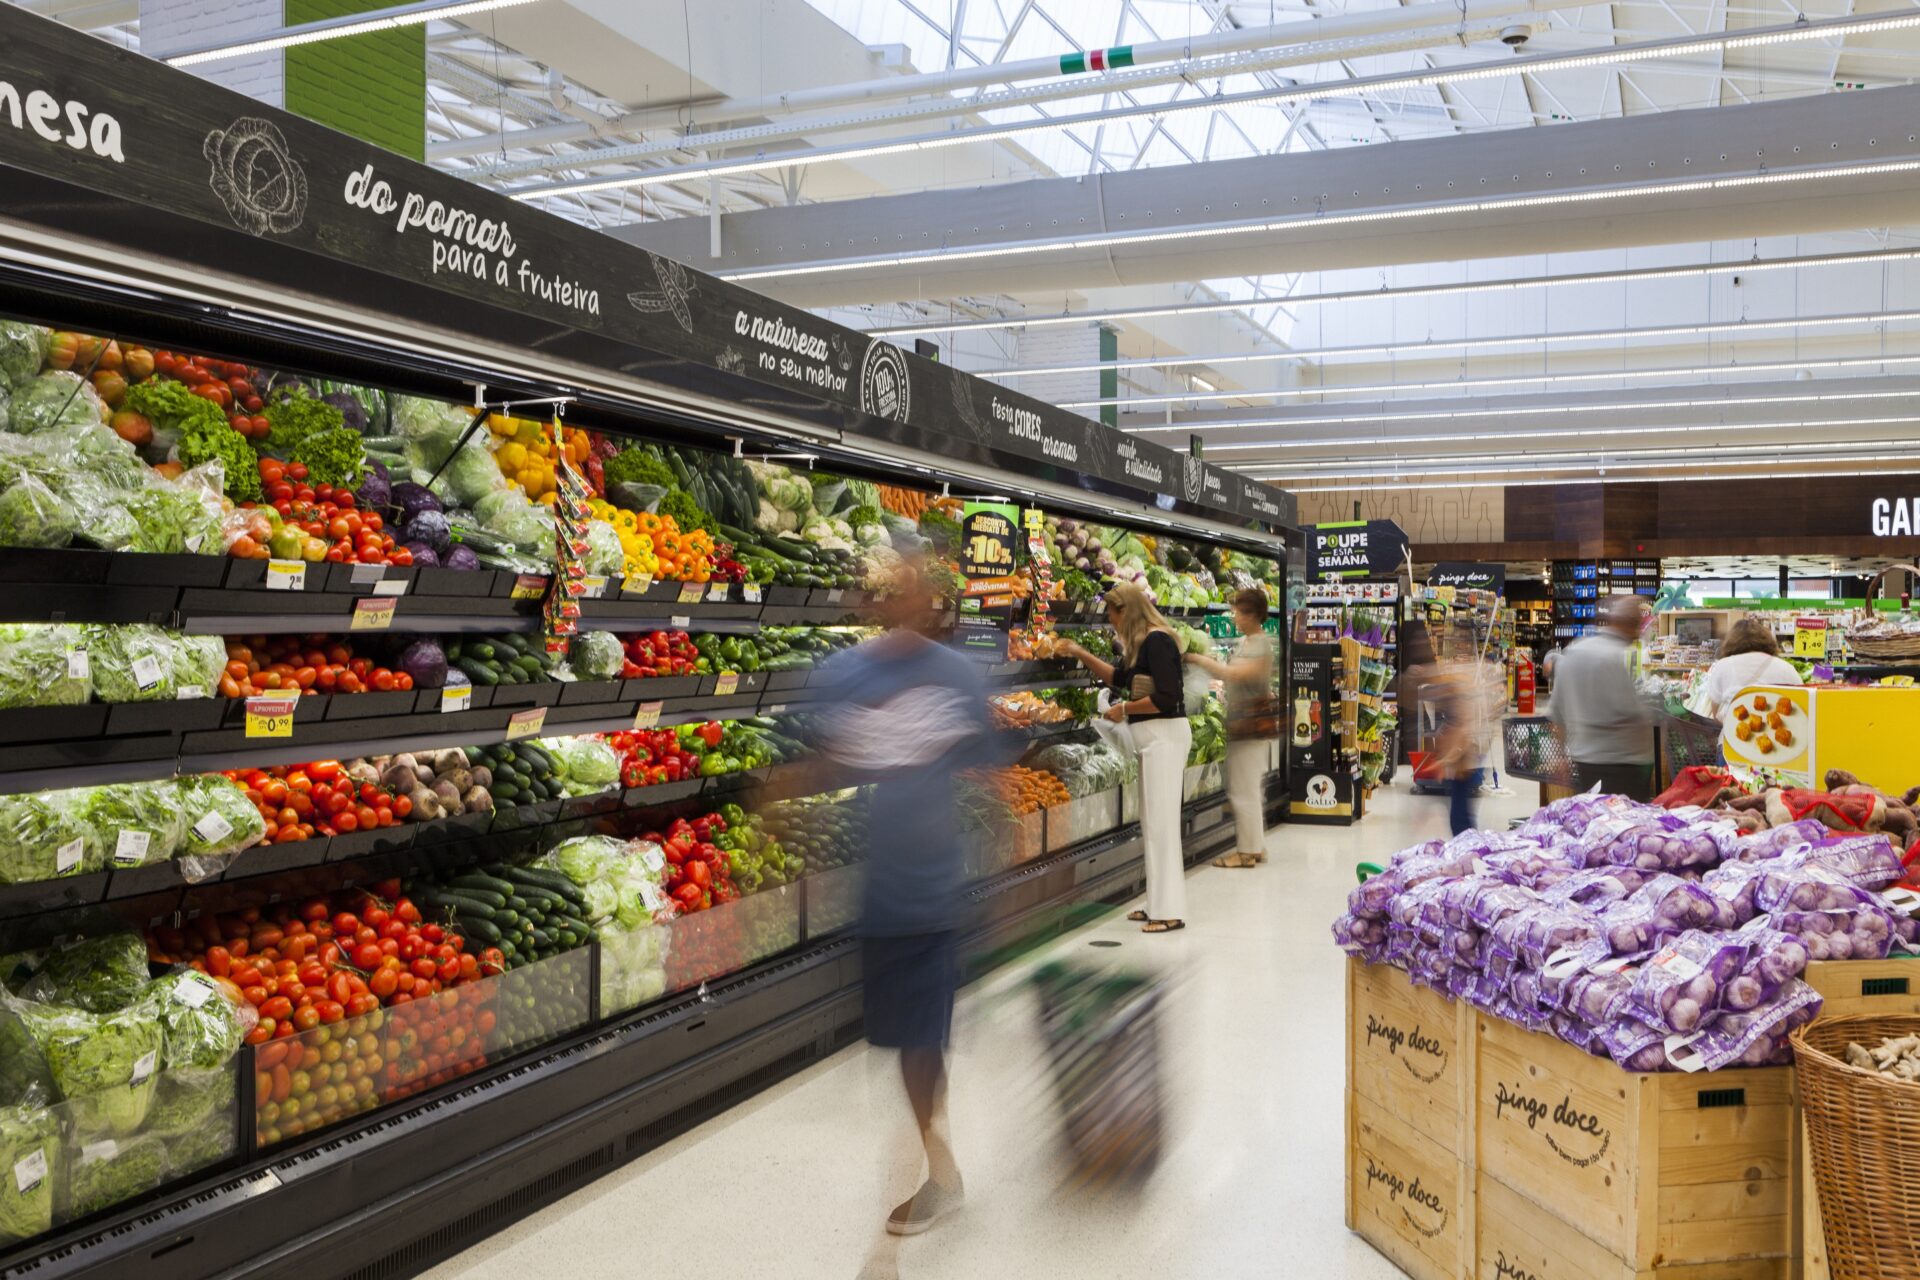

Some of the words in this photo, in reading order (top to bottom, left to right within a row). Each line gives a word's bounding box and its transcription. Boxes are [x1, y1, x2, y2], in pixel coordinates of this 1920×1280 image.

[344, 163, 398, 214] do
[397, 191, 517, 258] pomar
[432, 239, 487, 280] para
[495, 260, 509, 288] a
[517, 259, 600, 315] fruteira
[735, 310, 749, 335] a
[750, 317, 828, 362] natureza
[759, 352, 776, 371] no
[780, 358, 801, 381] seu
[806, 364, 847, 393] melhor
[875, 368, 895, 397] 100%
[992, 396, 1013, 424] festa
[1014, 408, 1042, 442] CORES
[1043, 435, 1078, 463] aromas
[971, 522, 999, 535] IMEDIATO
[1001, 528, 1009, 536] DE
[975, 515, 1007, 528] DESCONTO
[1317, 533, 1368, 549] POUPE
[1333, 548, 1353, 556] ESTA
[978, 567, 991, 575] TODA
[996, 568, 1008, 576] LOJA
[1318, 555, 1369, 567] SEMANA
[1439, 574, 1465, 586] pingo
[1467, 572, 1490, 581] doce
[1293, 661, 1320, 669] VINAGRE
[1366, 1014, 1404, 1055] pingo
[1408, 1024, 1443, 1057] doce
[1495, 1082, 1548, 1129] pingo
[1553, 1095, 1604, 1136] doce
[1558, 1148, 1572, 1162] bem
[1572, 1159, 1589, 1168] pagar
[1366, 1158, 1404, 1201] pingo
[1408, 1176, 1443, 1213] doce
